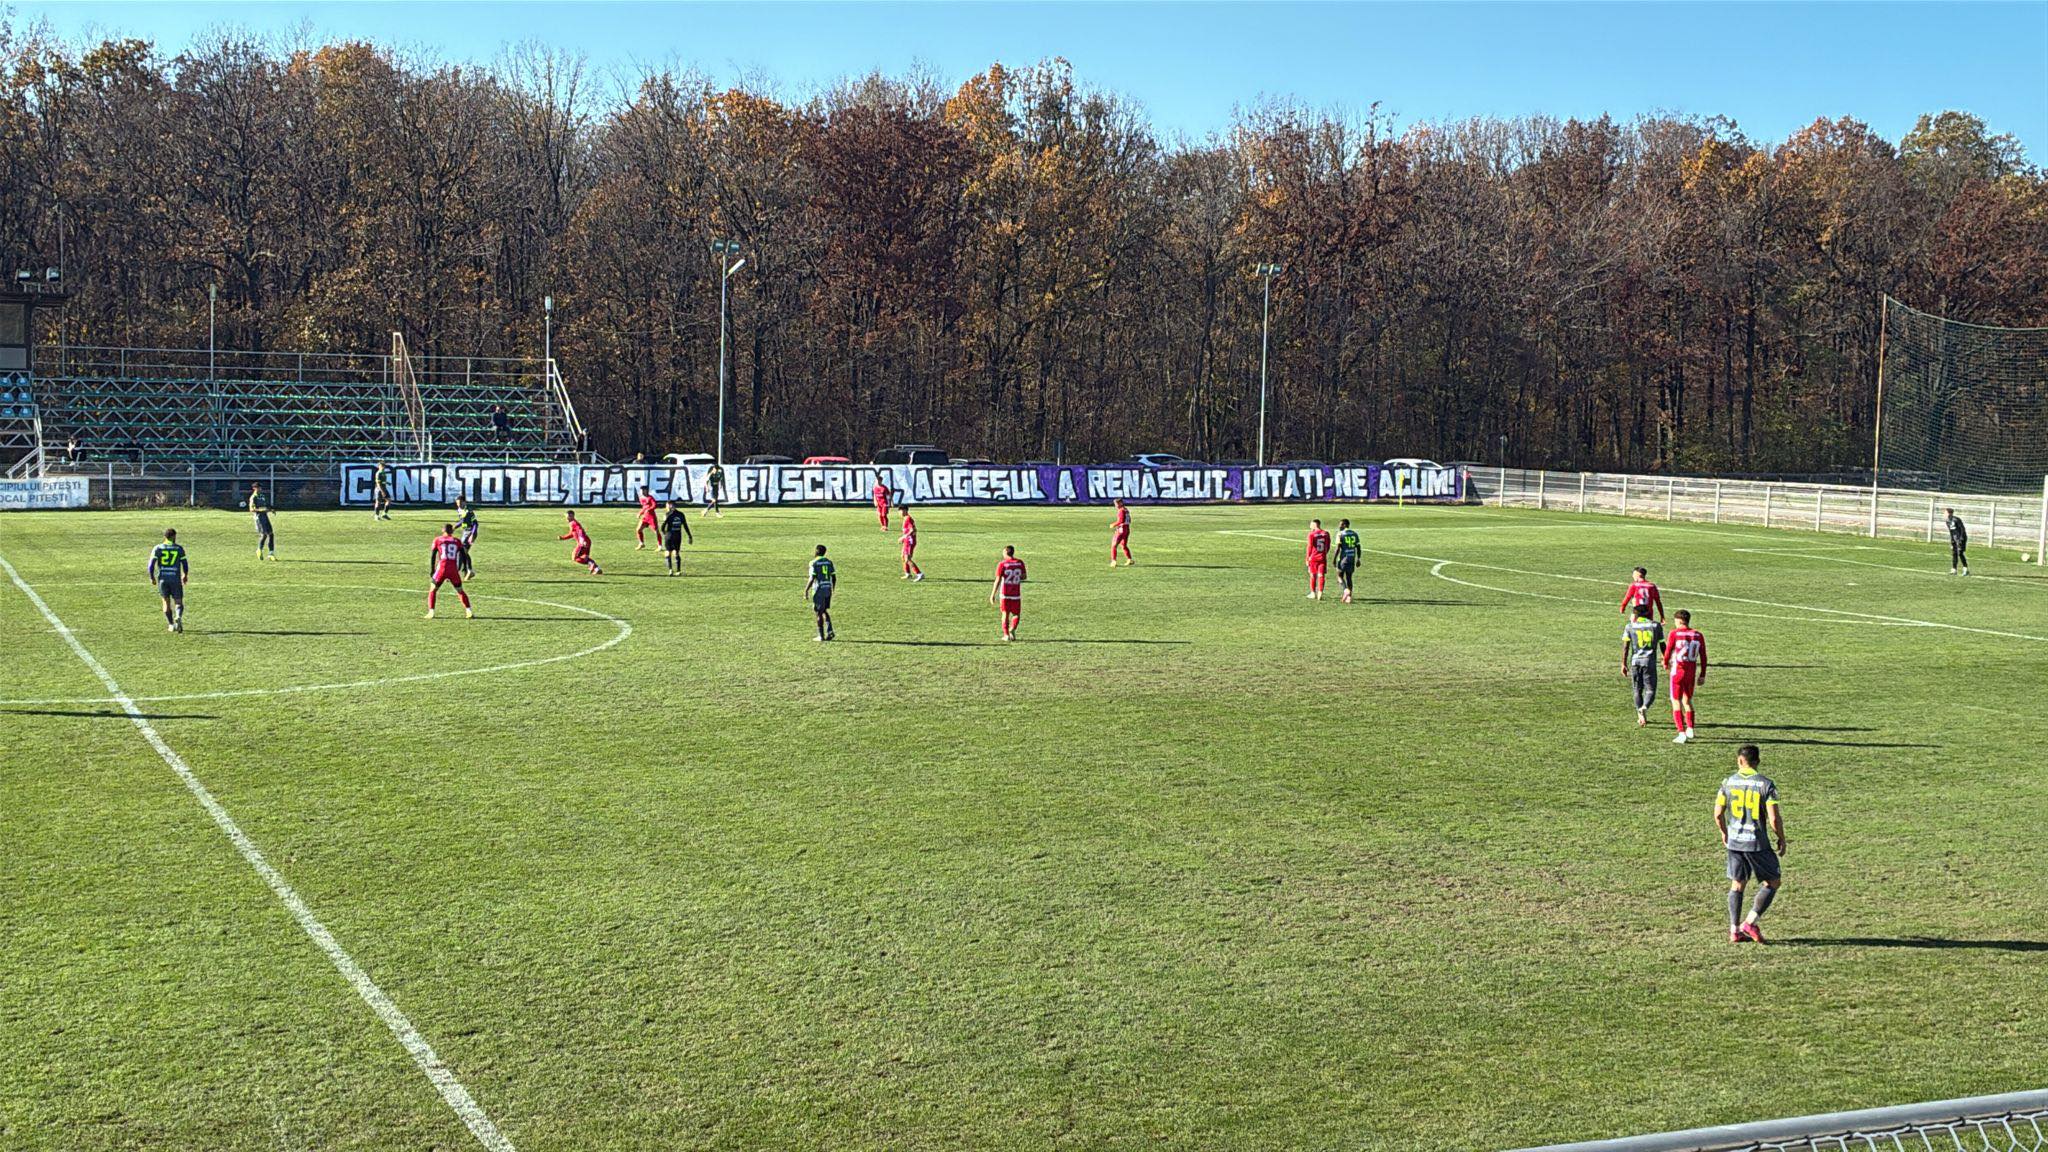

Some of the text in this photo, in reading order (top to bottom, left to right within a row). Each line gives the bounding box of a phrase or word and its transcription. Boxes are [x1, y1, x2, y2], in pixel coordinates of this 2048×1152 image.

[457, 467, 568, 502] TOTUL
[1058, 469, 1077, 499] A
[1379, 468, 1456, 498] ACUM!
[1316, 538, 1325, 552] 5
[1344, 535, 1356, 548] 42
[161, 550, 178, 566] 27
[440, 543, 458, 560] 19
[821, 564, 829, 579] 4
[1004, 568, 1022, 584] 28
[1675, 639, 1700, 662] 20
[1730, 788, 1760, 820] 24
